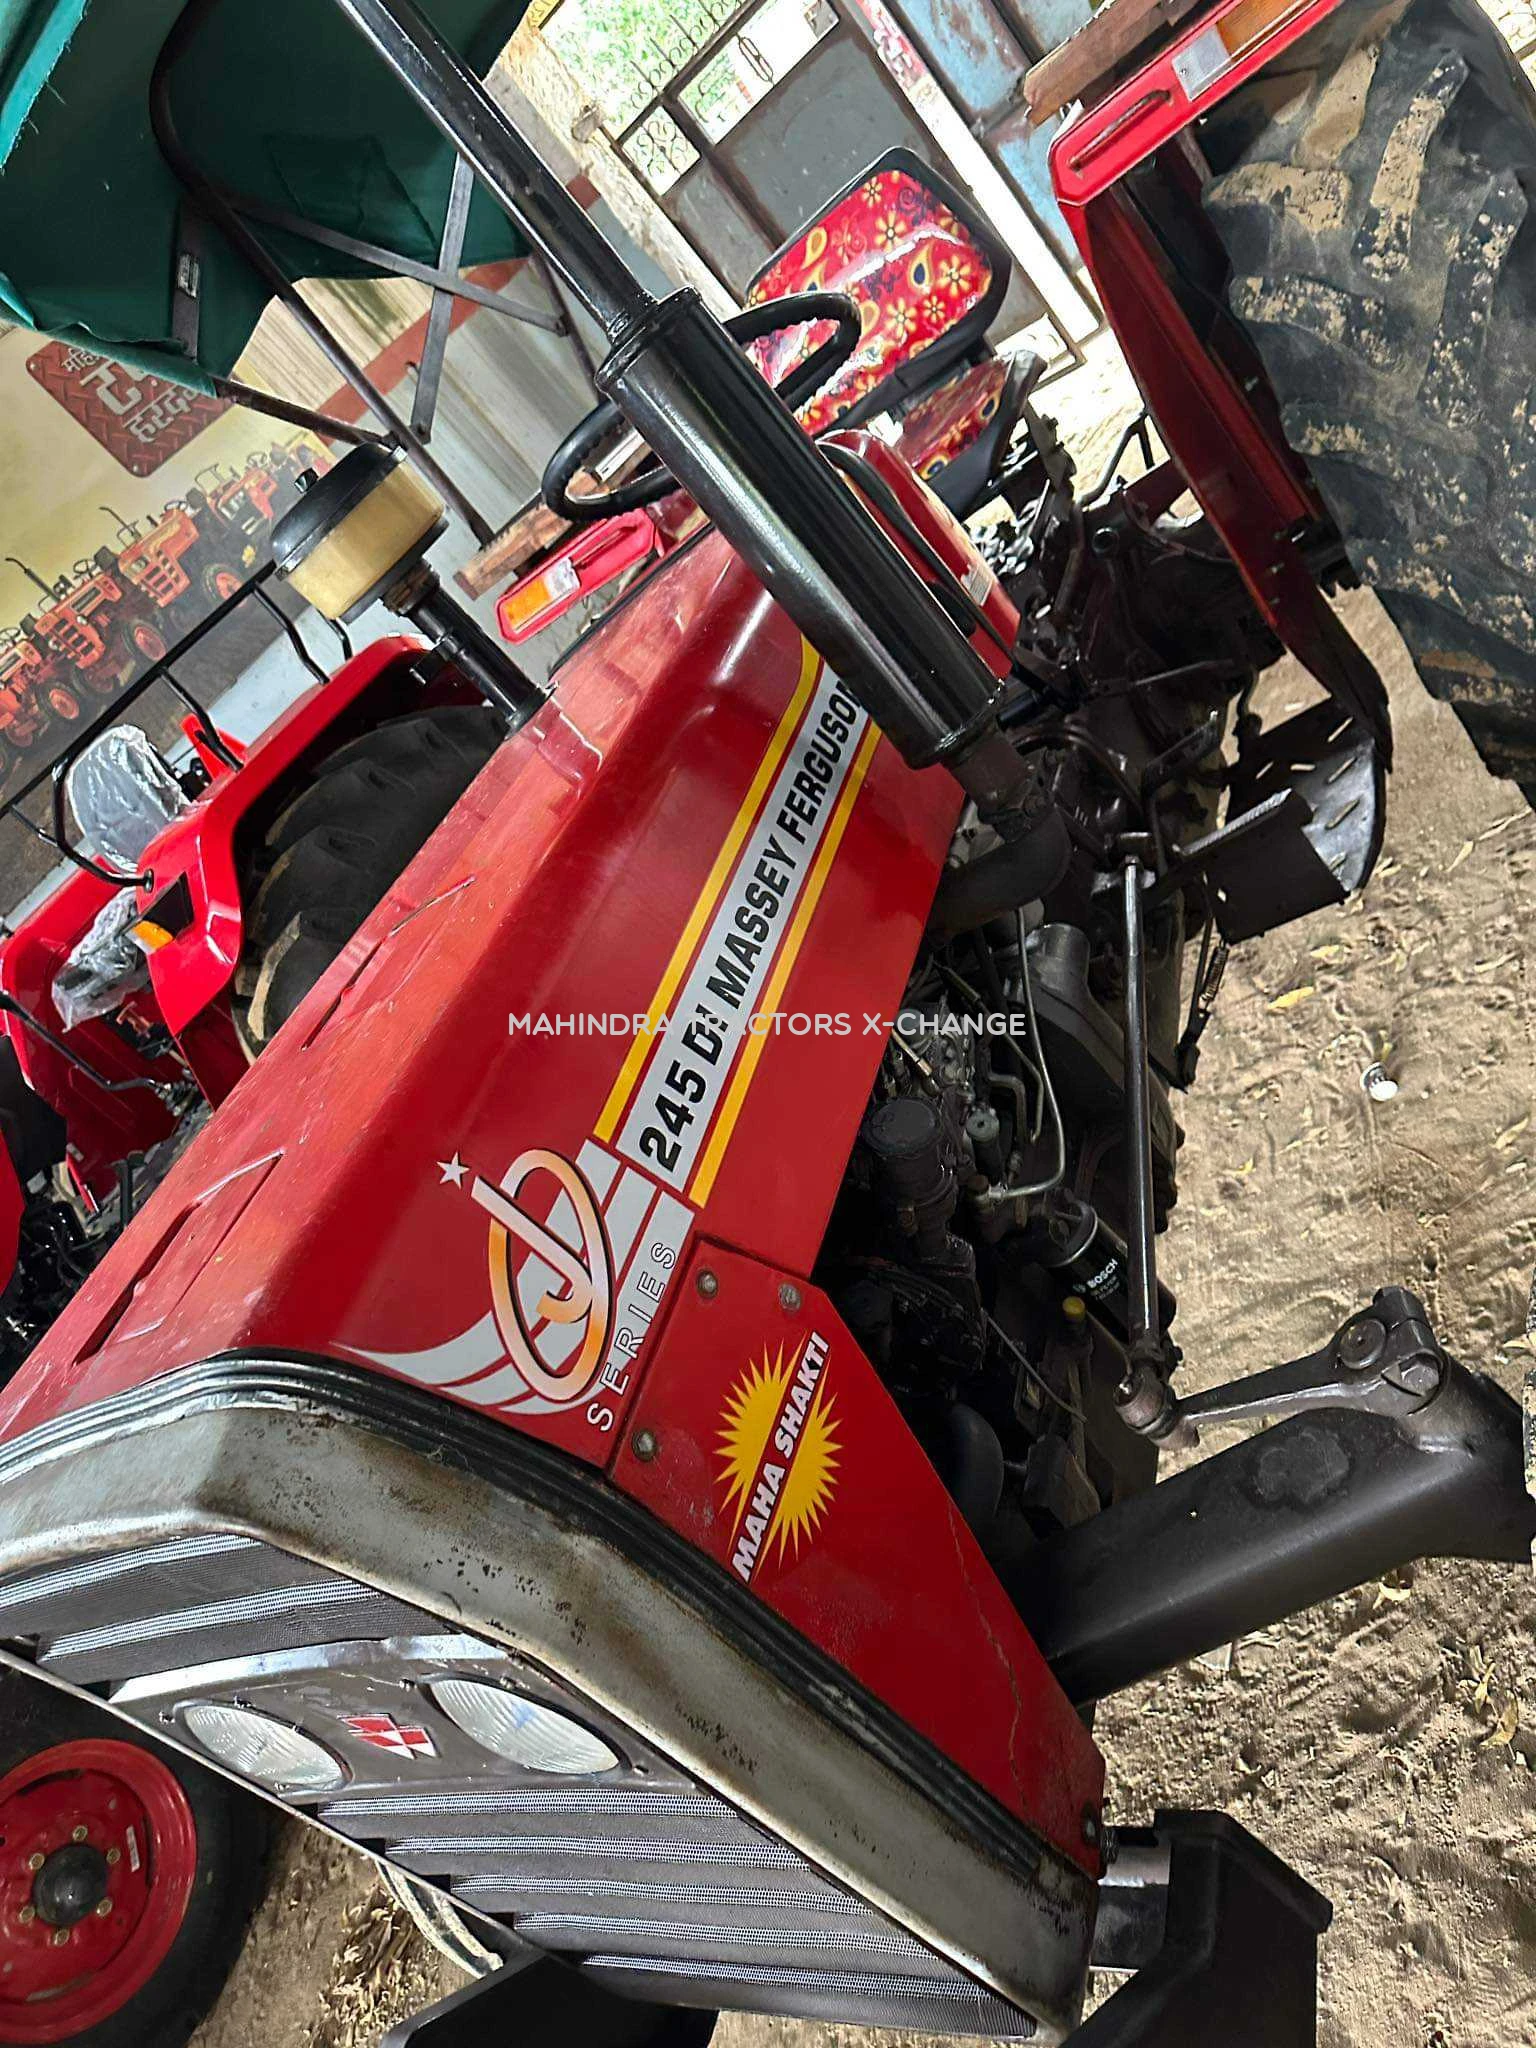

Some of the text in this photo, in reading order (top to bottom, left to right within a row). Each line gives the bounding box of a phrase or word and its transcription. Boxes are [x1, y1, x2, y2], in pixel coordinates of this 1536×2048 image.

[638, 1058, 707, 1174] 245
[705, 833, 797, 1010] MASSEY
[586, 1241, 677, 1432] SERIES
[1086, 1258, 1119, 1289] BOSCH
[732, 1331, 830, 1584] MAHA SHAKTI
